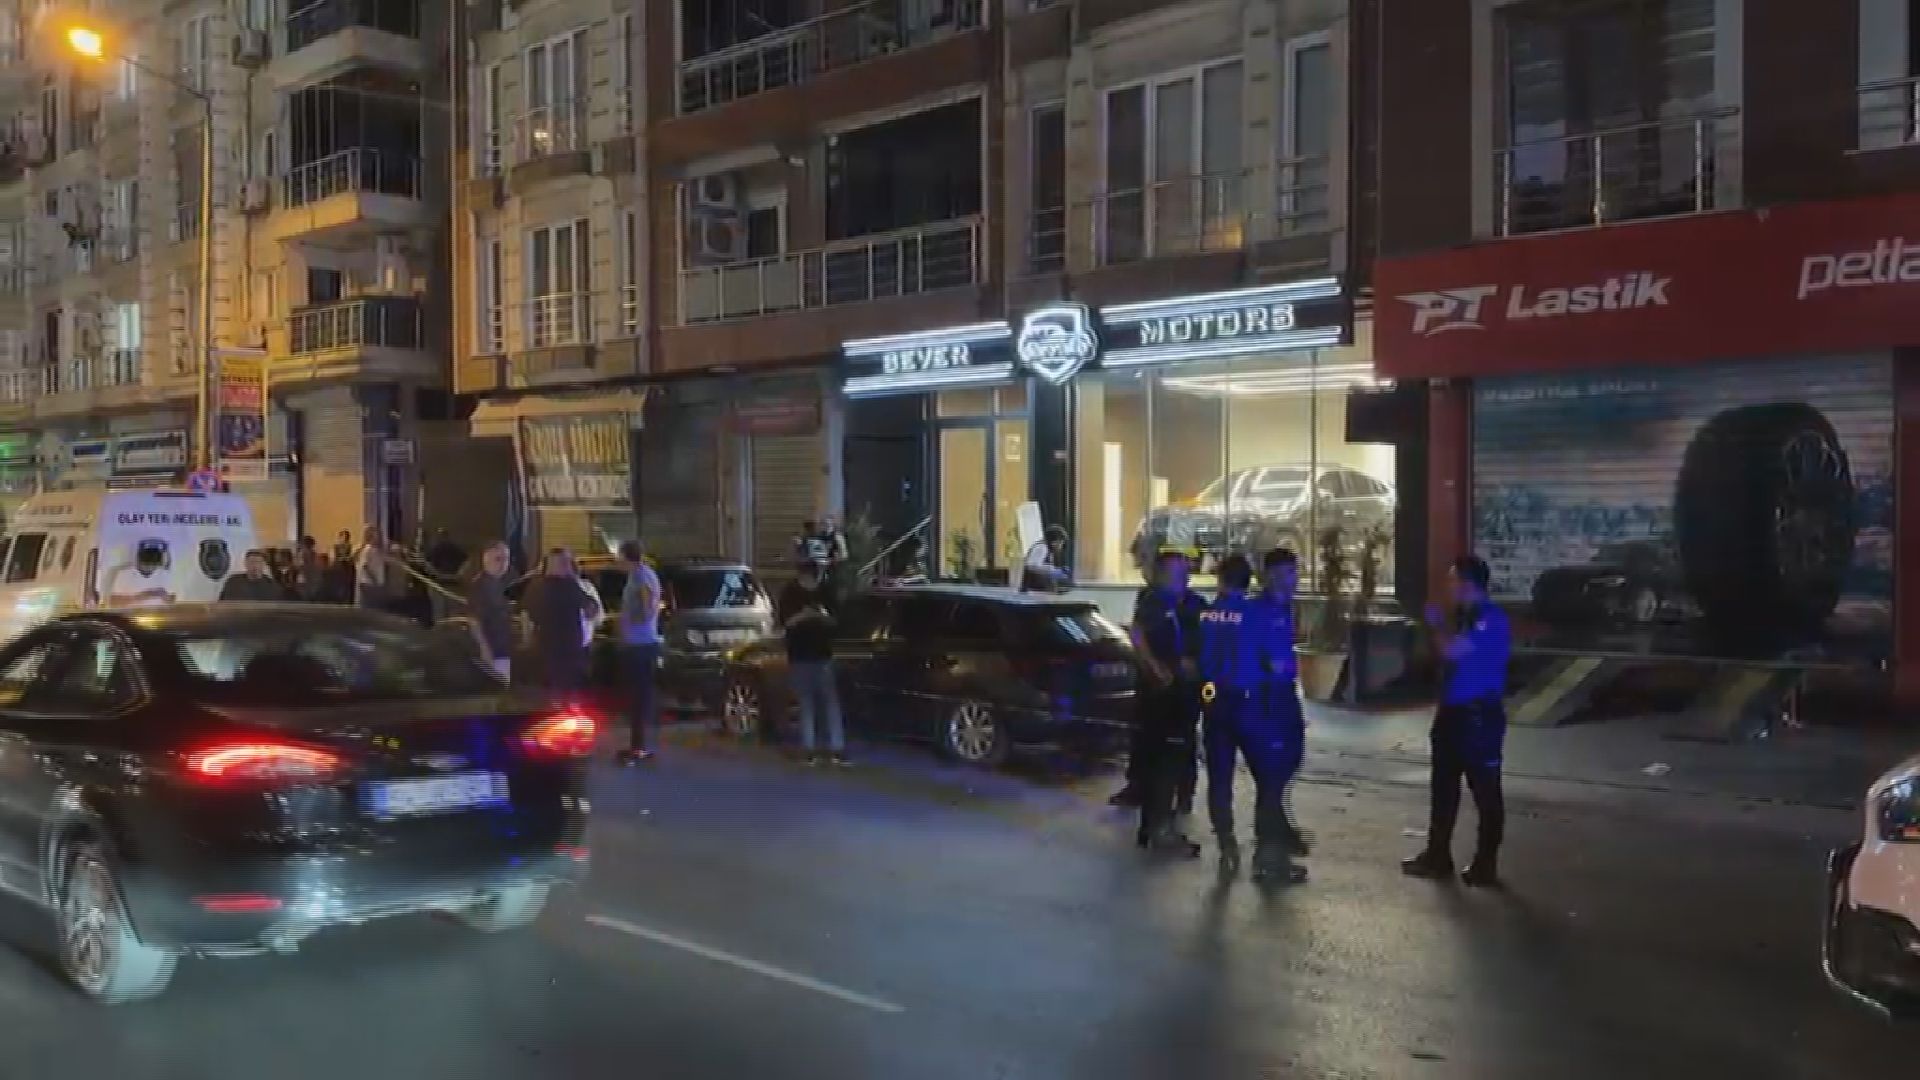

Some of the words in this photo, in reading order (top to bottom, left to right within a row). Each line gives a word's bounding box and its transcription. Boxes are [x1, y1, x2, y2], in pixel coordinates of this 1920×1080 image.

[1396, 284, 1498, 333] PT
[1505, 271, 1673, 319] Lastik
[1139, 304, 1295, 344] MOTORS
[117, 513, 145, 525] OLAY
